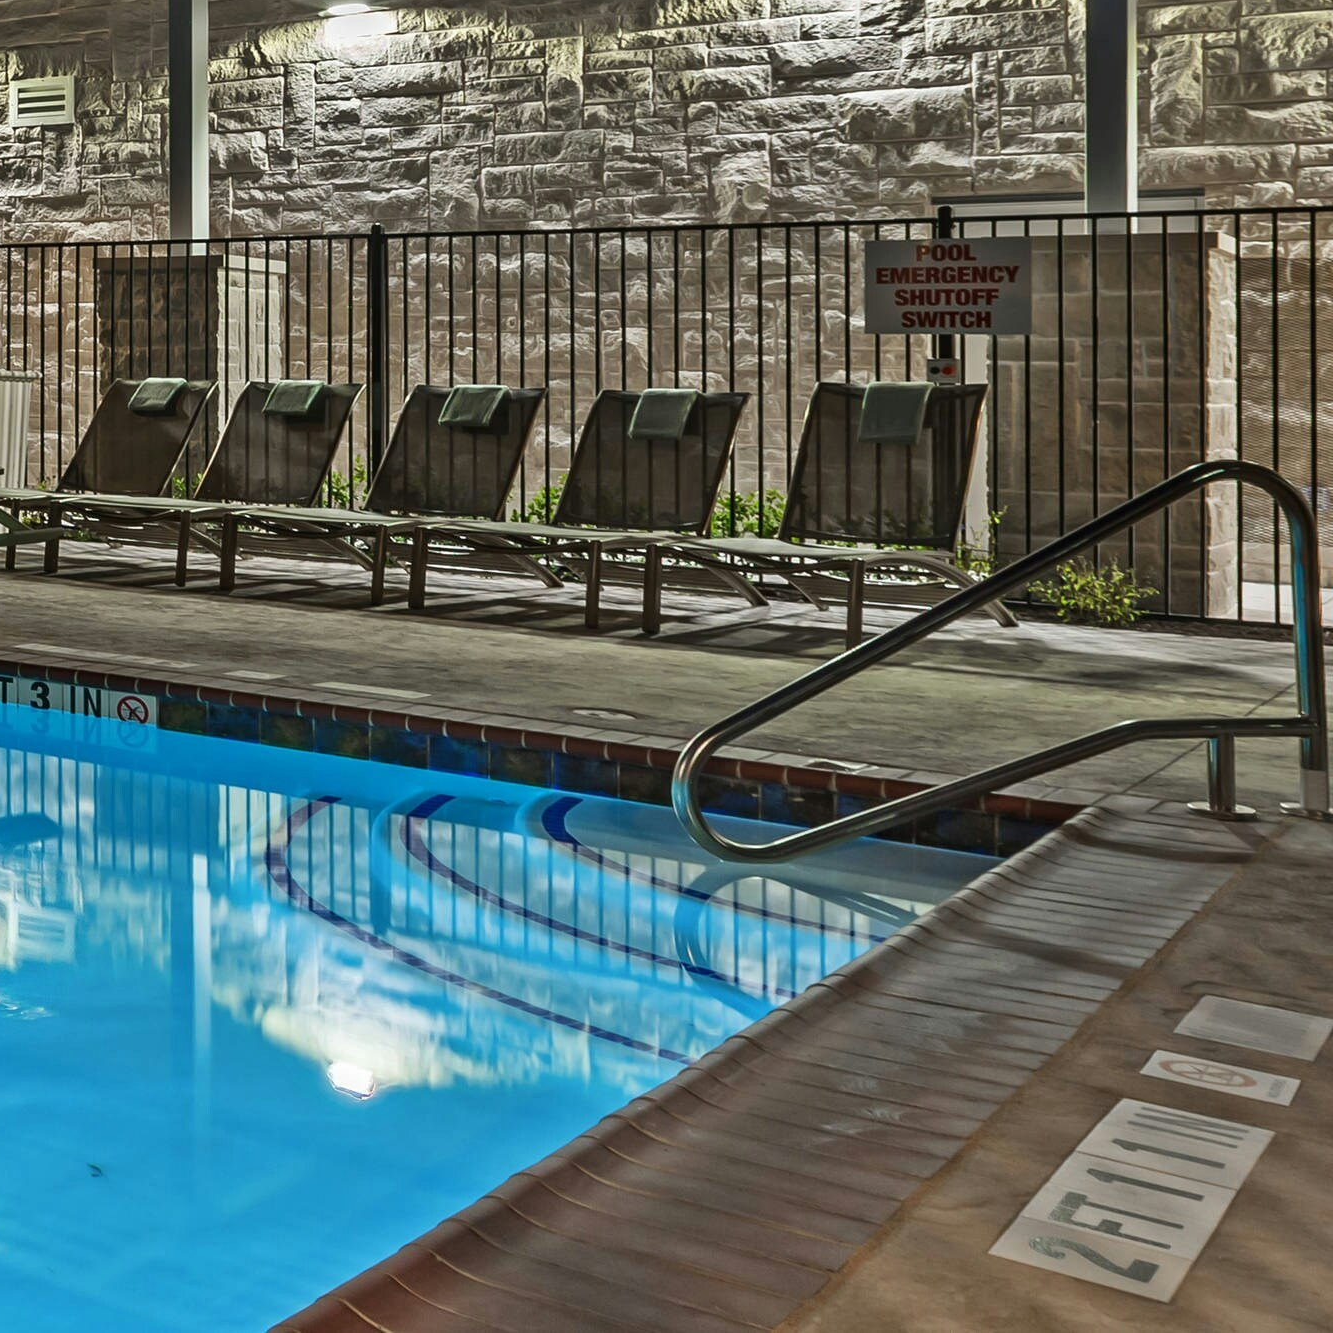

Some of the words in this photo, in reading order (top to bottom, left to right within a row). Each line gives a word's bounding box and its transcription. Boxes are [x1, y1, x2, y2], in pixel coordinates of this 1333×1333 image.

[915, 244, 976, 261] POOL
[875, 265, 1020, 284] EMERGENCY
[894, 288, 1000, 306] SHUTOFF
[901, 311, 993, 328] SWITCH
[29, 681, 50, 710] 3
[69, 685, 102, 717] IN
[1127, 1106, 1250, 1149] IN
[1047, 1191, 1185, 1250] FT
[1027, 1235, 1160, 1284] 2
